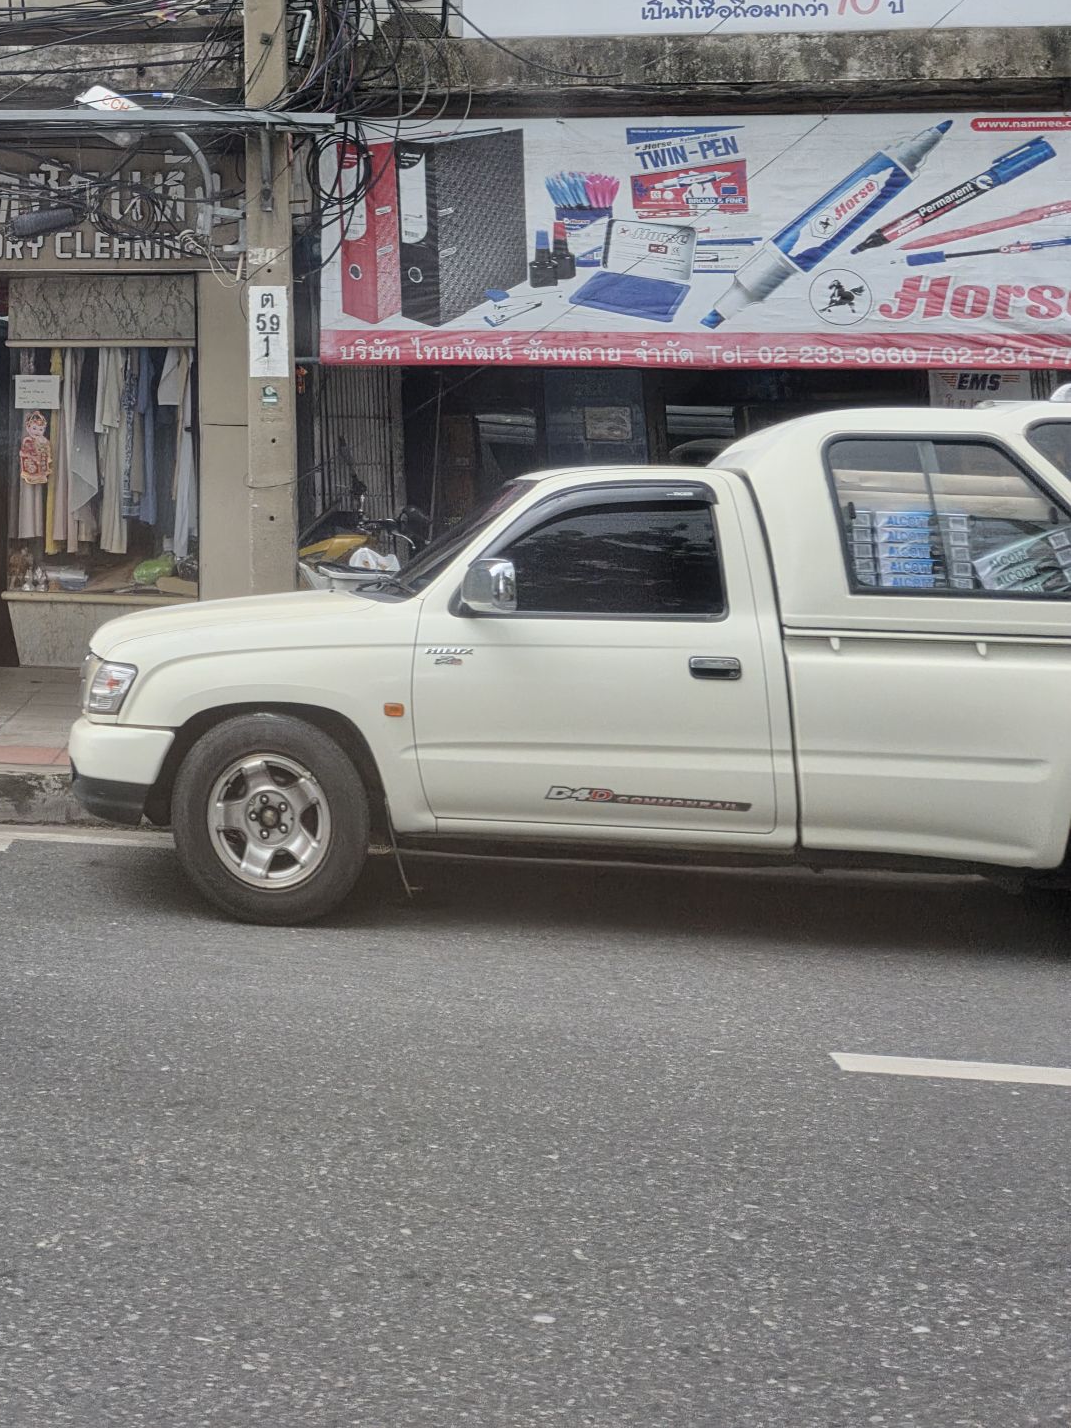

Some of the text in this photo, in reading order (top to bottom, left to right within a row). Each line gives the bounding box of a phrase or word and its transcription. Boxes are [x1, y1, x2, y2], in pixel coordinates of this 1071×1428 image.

[918, 182, 974, 217] Permanent
[55, 231, 201, 259] CLEANIN
[879, 275, 1071, 320] Hors
[256, 313, 280, 332] 59
[262, 335, 270, 357] 1
[340, 338, 400, 360] บริษัท
[411, 336, 513, 361] ไทยพัฒน์
[523, 339, 621, 361] ซัพพลาย
[633, 339, 694, 363] จำกัด
[706, 345, 749, 364] Tel.
[758, 346, 916, 364] 02-233-3660
[957, 373, 1002, 391] EMS
